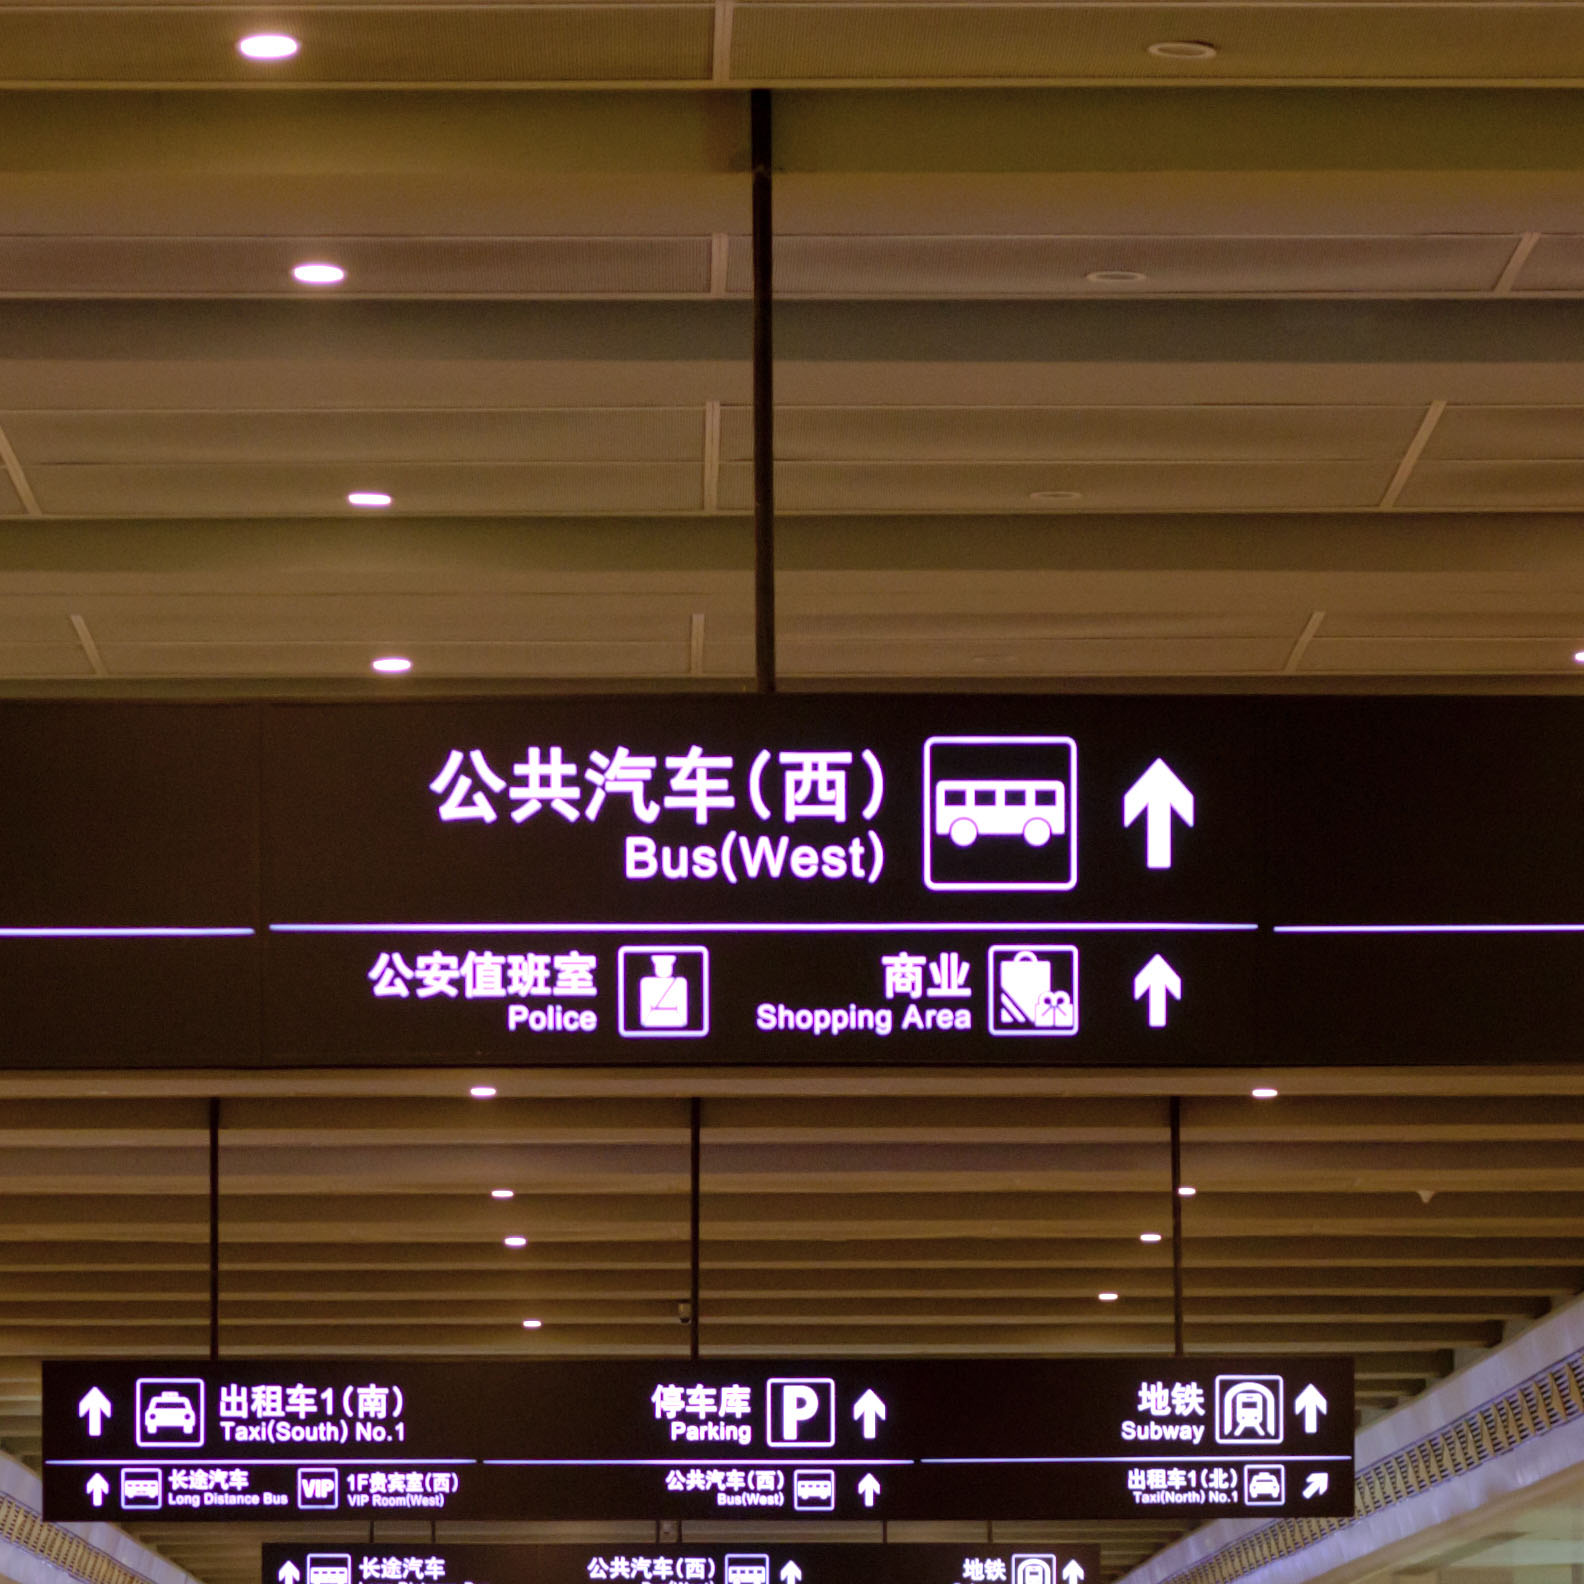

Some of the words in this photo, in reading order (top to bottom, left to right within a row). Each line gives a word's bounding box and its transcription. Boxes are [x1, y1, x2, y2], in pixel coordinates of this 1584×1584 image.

[430, 746, 883, 824] 公共汽车(西)
[626, 831, 883, 883] Bus(West)
[369, 951, 597, 998] 公安值班室
[882, 952, 971, 998] 商业
[509, 1005, 597, 1030] Police
[757, 1004, 891, 1035] Shopping
[902, 1004, 971, 1029] Area
[220, 1384, 402, 1420] 出租车1(南)
[651, 1384, 751, 1419] 停车库
[1138, 1382, 1205, 1416] 地铁
[220, 1419, 348, 1443] Taxi(South)
[356, 1422, 403, 1441] No.1
[671, 1421, 751, 1444] Parking
[1122, 1421, 1204, 1444] Subway
[168, 1469, 248, 1490] 长途汽车
[301, 1479, 335, 1498] VIP
[347, 1472, 458, 1493] 1F贵宾室(西)
[666, 1469, 784, 1491] 公共汽车(西)
[1128, 1468, 1237, 1490] 出租车1(北)
[169, 1493, 200, 1507] Long
[204, 1492, 259, 1505] Distance
[263, 1492, 288, 1504] Bus
[348, 1494, 369, 1506] VIP
[718, 1492, 784, 1506] Bus(West)
[359, 1557, 445, 1580] 长途汽车
[588, 1556, 715, 1582] 公共汽车(西)
[963, 1558, 1006, 1581] 地铁
